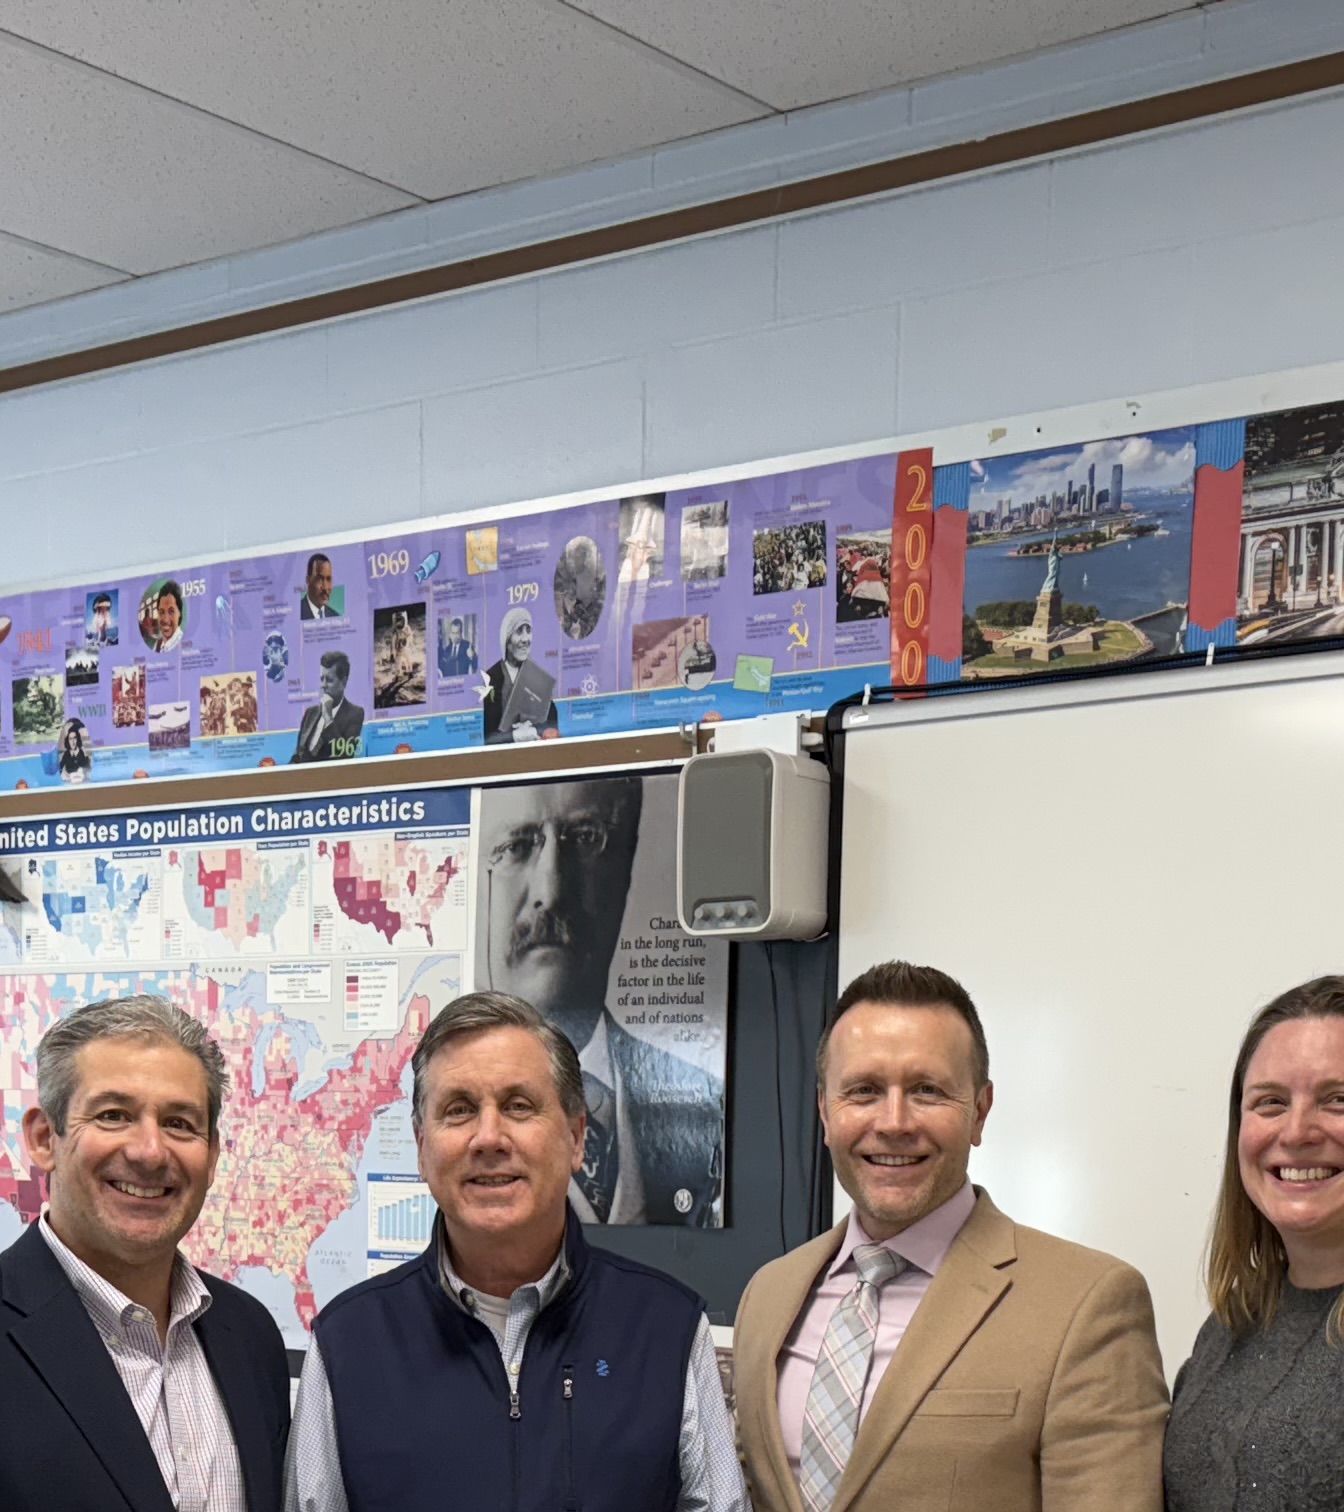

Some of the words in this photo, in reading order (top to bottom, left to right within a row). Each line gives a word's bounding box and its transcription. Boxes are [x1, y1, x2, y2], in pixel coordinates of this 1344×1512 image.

[367, 548, 410, 580] 1969
[901, 464, 928, 686] 2000
[180, 578, 206, 598] 1955
[506, 581, 539, 606] 1979
[328, 736, 363, 759] 1963
[54, 821, 120, 846] States
[125, 811, 243, 843] Population
[250, 796, 426, 833] Characteristics
[649, 917, 681, 930] Chara
[620, 937, 631, 950] in
[634, 936, 653, 950] the
[655, 935, 680, 951] long
[682, 937, 706, 949] run,
[629, 957, 638, 968] is
[641, 955, 658, 968] the
[661, 954, 706, 967] decisive
[617, 974, 649, 987] factor
[652, 974, 663, 986] in
[666, 973, 684, 986] the
[687, 972, 705, 985] life
[617, 993, 630, 1006] of
[631, 996, 645, 1006] an
[647, 991, 705, 1005] individual
[625, 1012, 646, 1025] and
[648, 1011, 661, 1024] of
[663, 1011, 704, 1024] nations
